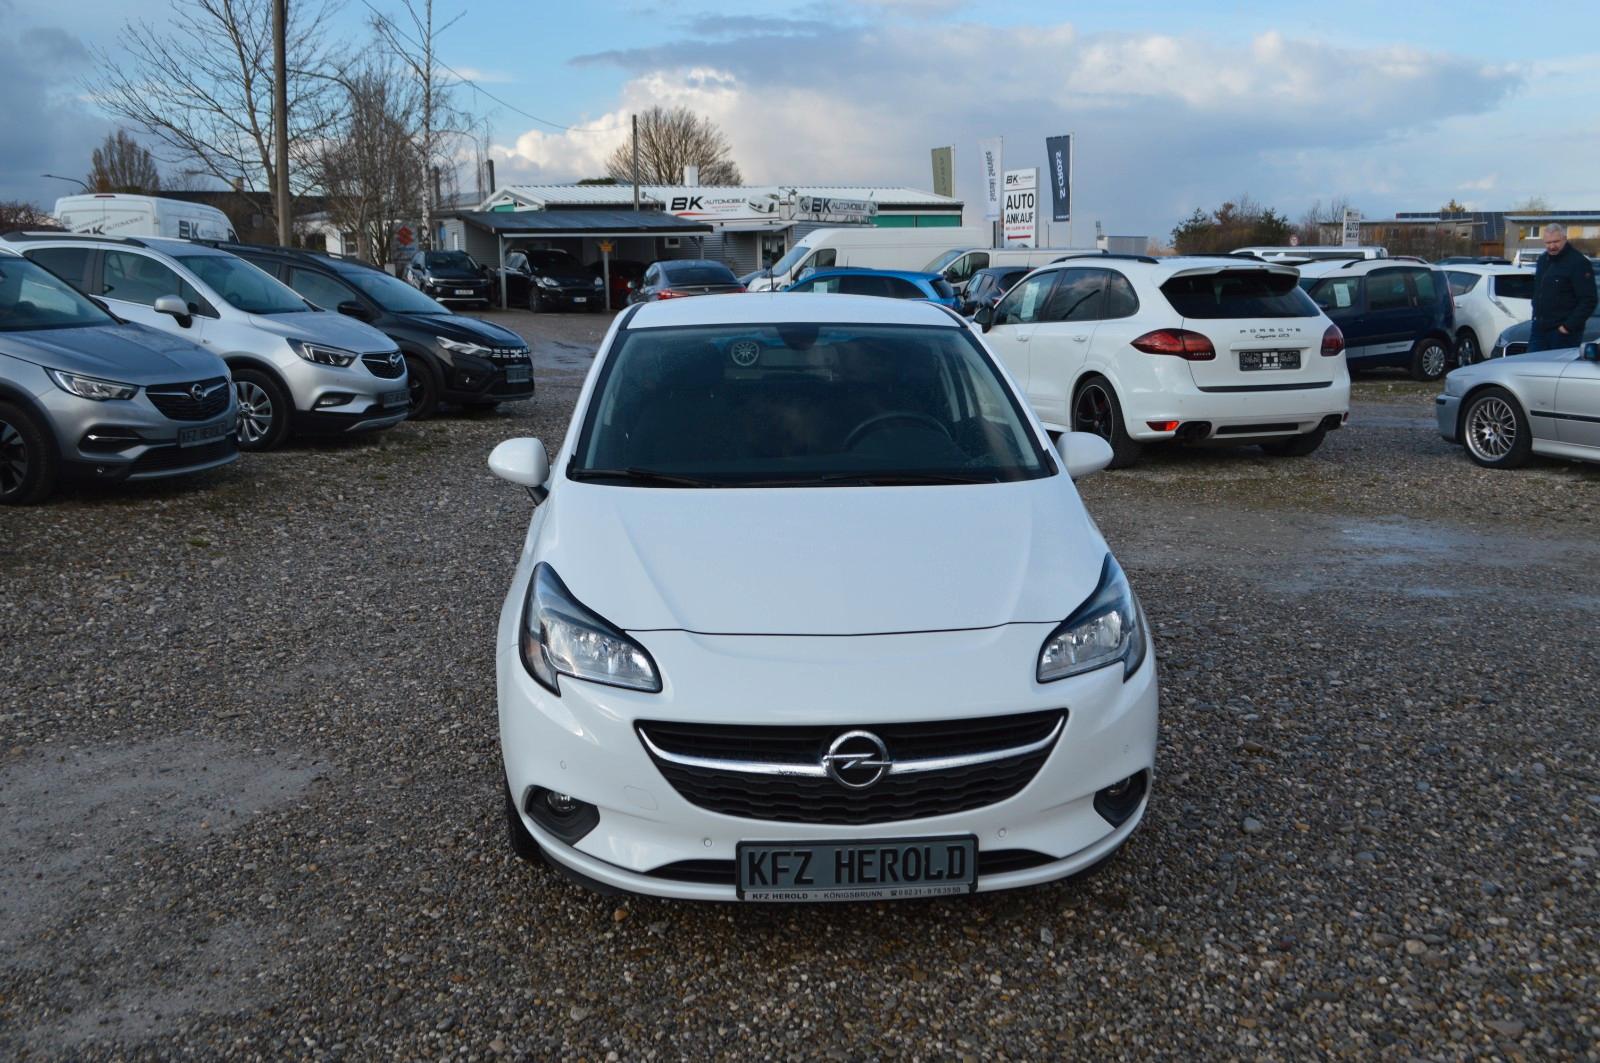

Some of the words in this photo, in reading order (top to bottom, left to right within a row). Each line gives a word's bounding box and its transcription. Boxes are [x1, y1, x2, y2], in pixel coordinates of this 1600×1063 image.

[1006, 175, 1018, 184] BK
[671, 196, 704, 211] BK
[812, 197, 831, 214] BK
[831, 202, 867, 211] AUTOMOBILE
[1006, 193, 1034, 210] AUTO
[1006, 211, 1033, 224] ANKAUF
[179, 220, 200, 240] BK
[748, 851, 814, 885] KFZ
[835, 845, 966, 884] HEROLD
[824, 890, 882, 898] KÖNIGSBRUNN
